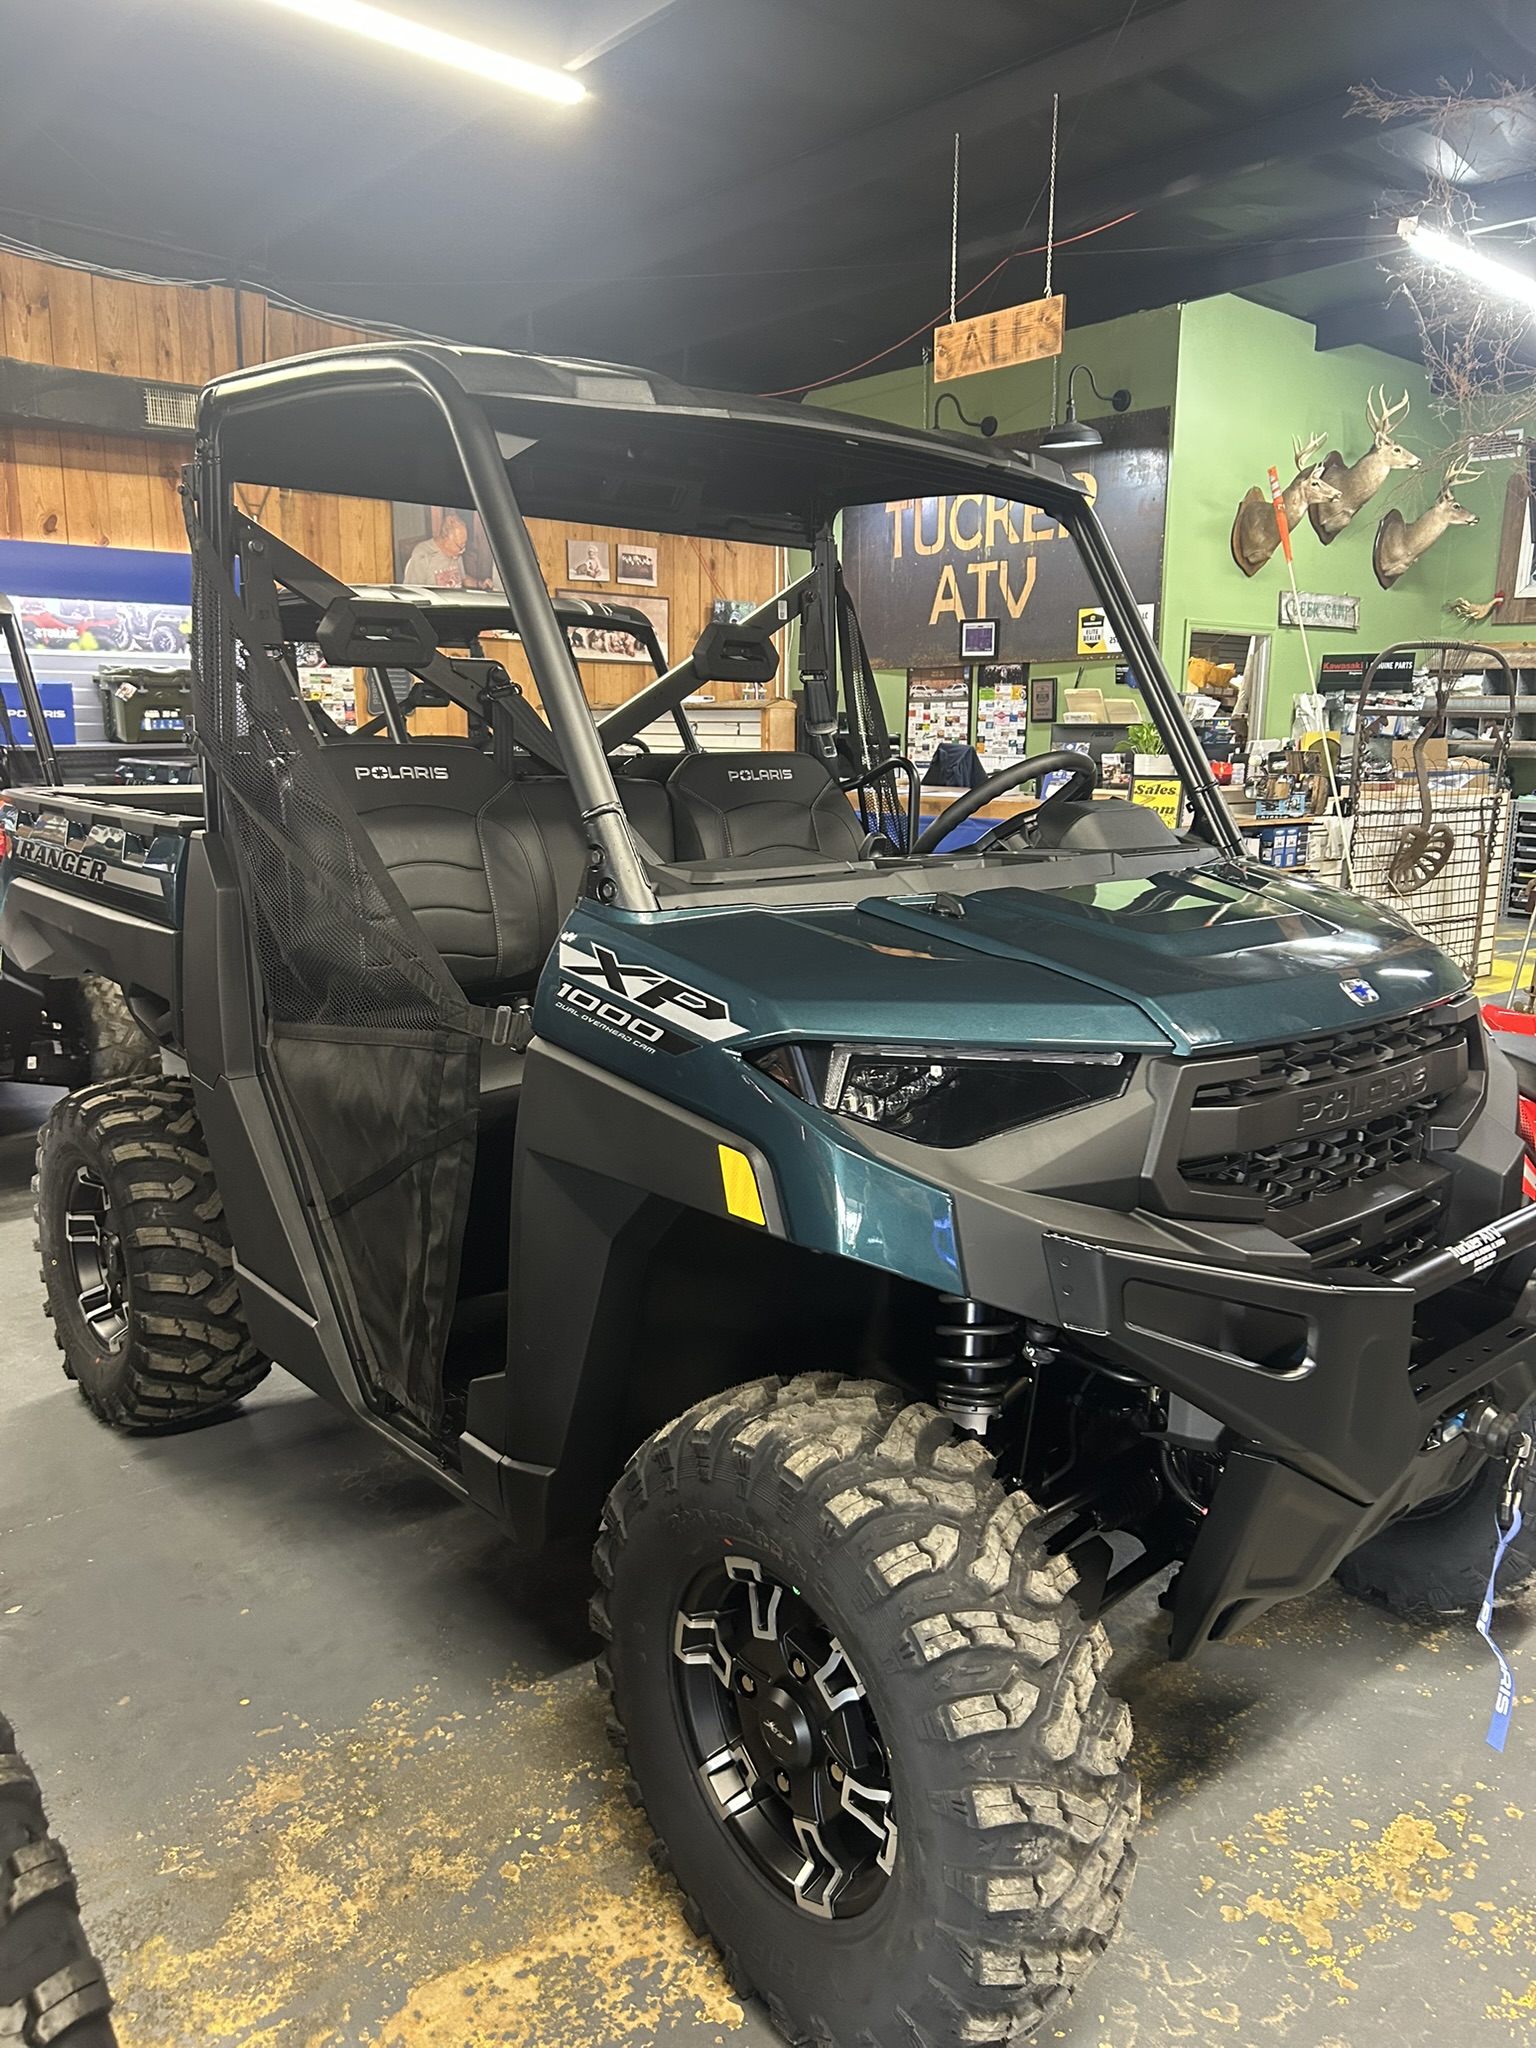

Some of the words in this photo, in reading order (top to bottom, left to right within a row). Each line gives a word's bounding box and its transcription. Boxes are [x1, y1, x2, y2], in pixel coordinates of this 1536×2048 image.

[936, 298, 1061, 379] SALES
[929, 556, 1037, 625] ATV
[1325, 603, 1350, 621] CAMP
[34, 627, 79, 639] STORAGE
[1083, 634, 1101, 642] DEALER
[1323, 662, 1364, 670] Kawasaki
[1394, 661, 1413, 670] PARTS
[355, 766, 449, 780] POLARIS
[727, 769, 793, 782] POLARIS
[1134, 784, 1177, 795] Sales
[19, 838, 107, 884] RANGER
[562, 943, 730, 1021] XP
[555, 1001, 579, 1017] DUAL
[580, 1014, 632, 1043] OVERHEAD
[632, 1040, 656, 1055] CAM
[557, 982, 665, 1043] 1000
[1302, 1066, 1428, 1124] POLARIS
